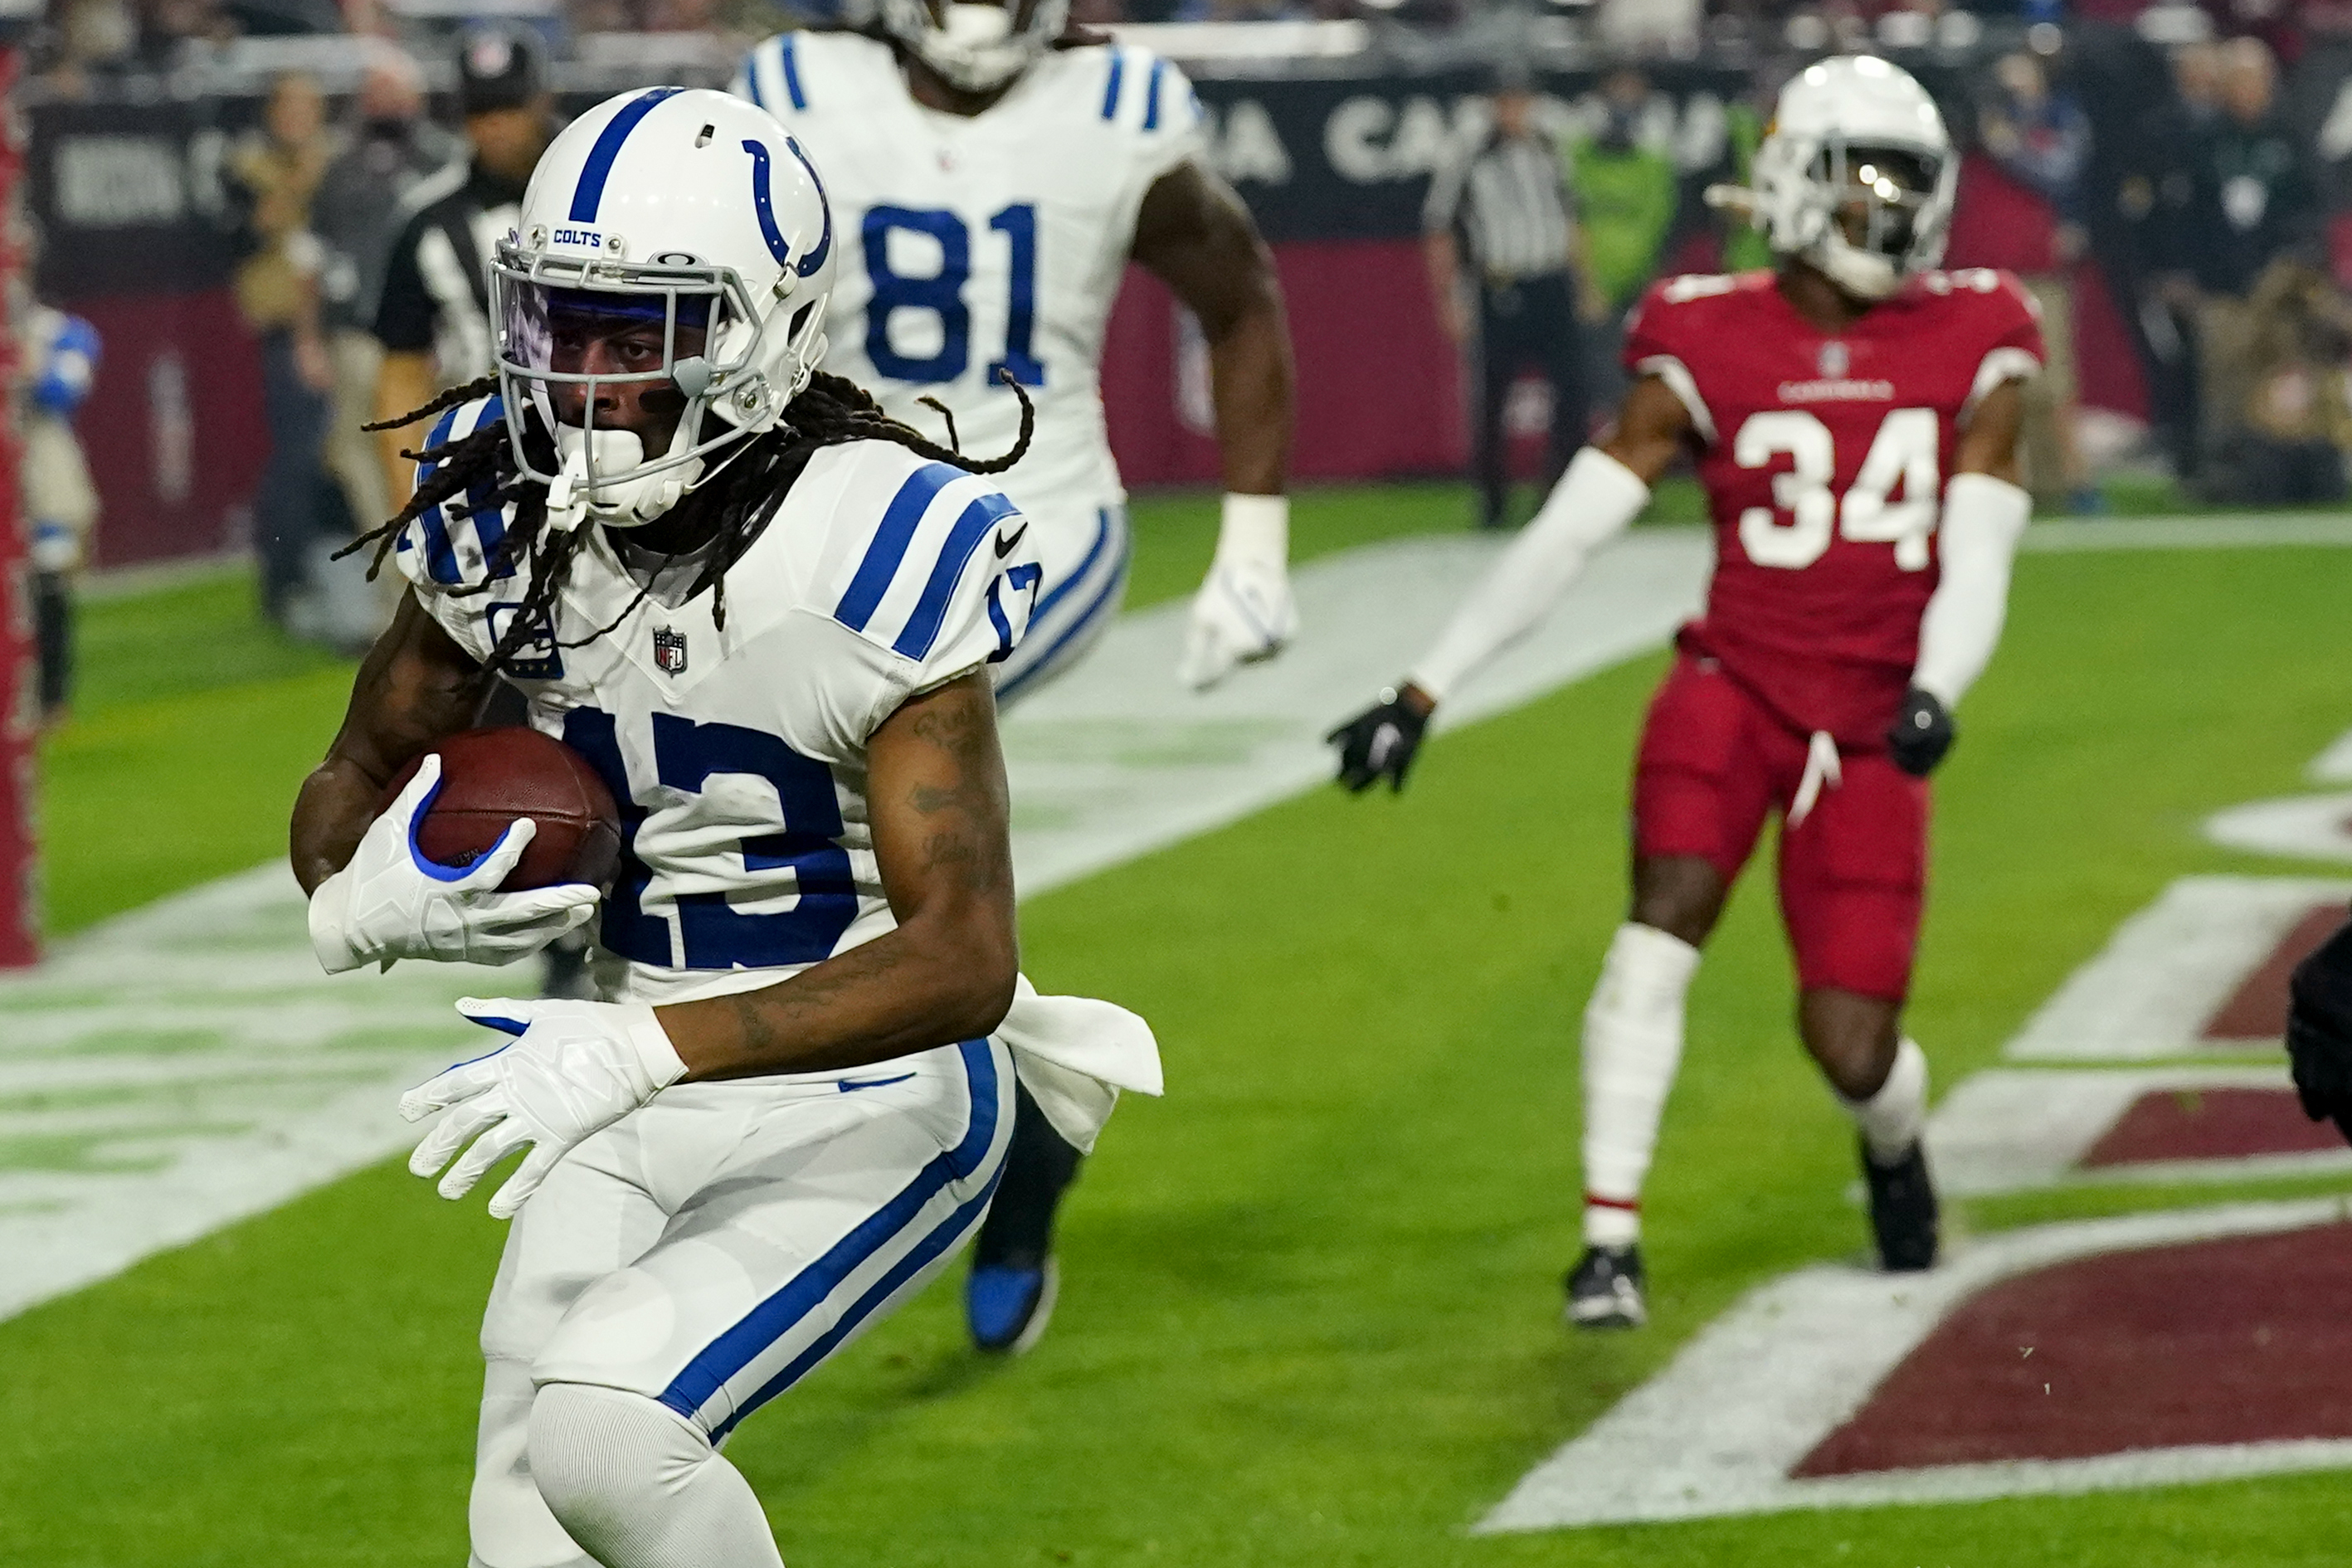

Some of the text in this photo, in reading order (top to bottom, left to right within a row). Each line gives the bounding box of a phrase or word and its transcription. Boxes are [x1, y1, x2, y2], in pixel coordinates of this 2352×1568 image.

[554, 230, 601, 247] COLTS
[863, 206, 1043, 386] 81
[1735, 407, 1940, 572] 34
[562, 705, 859, 969] 13
